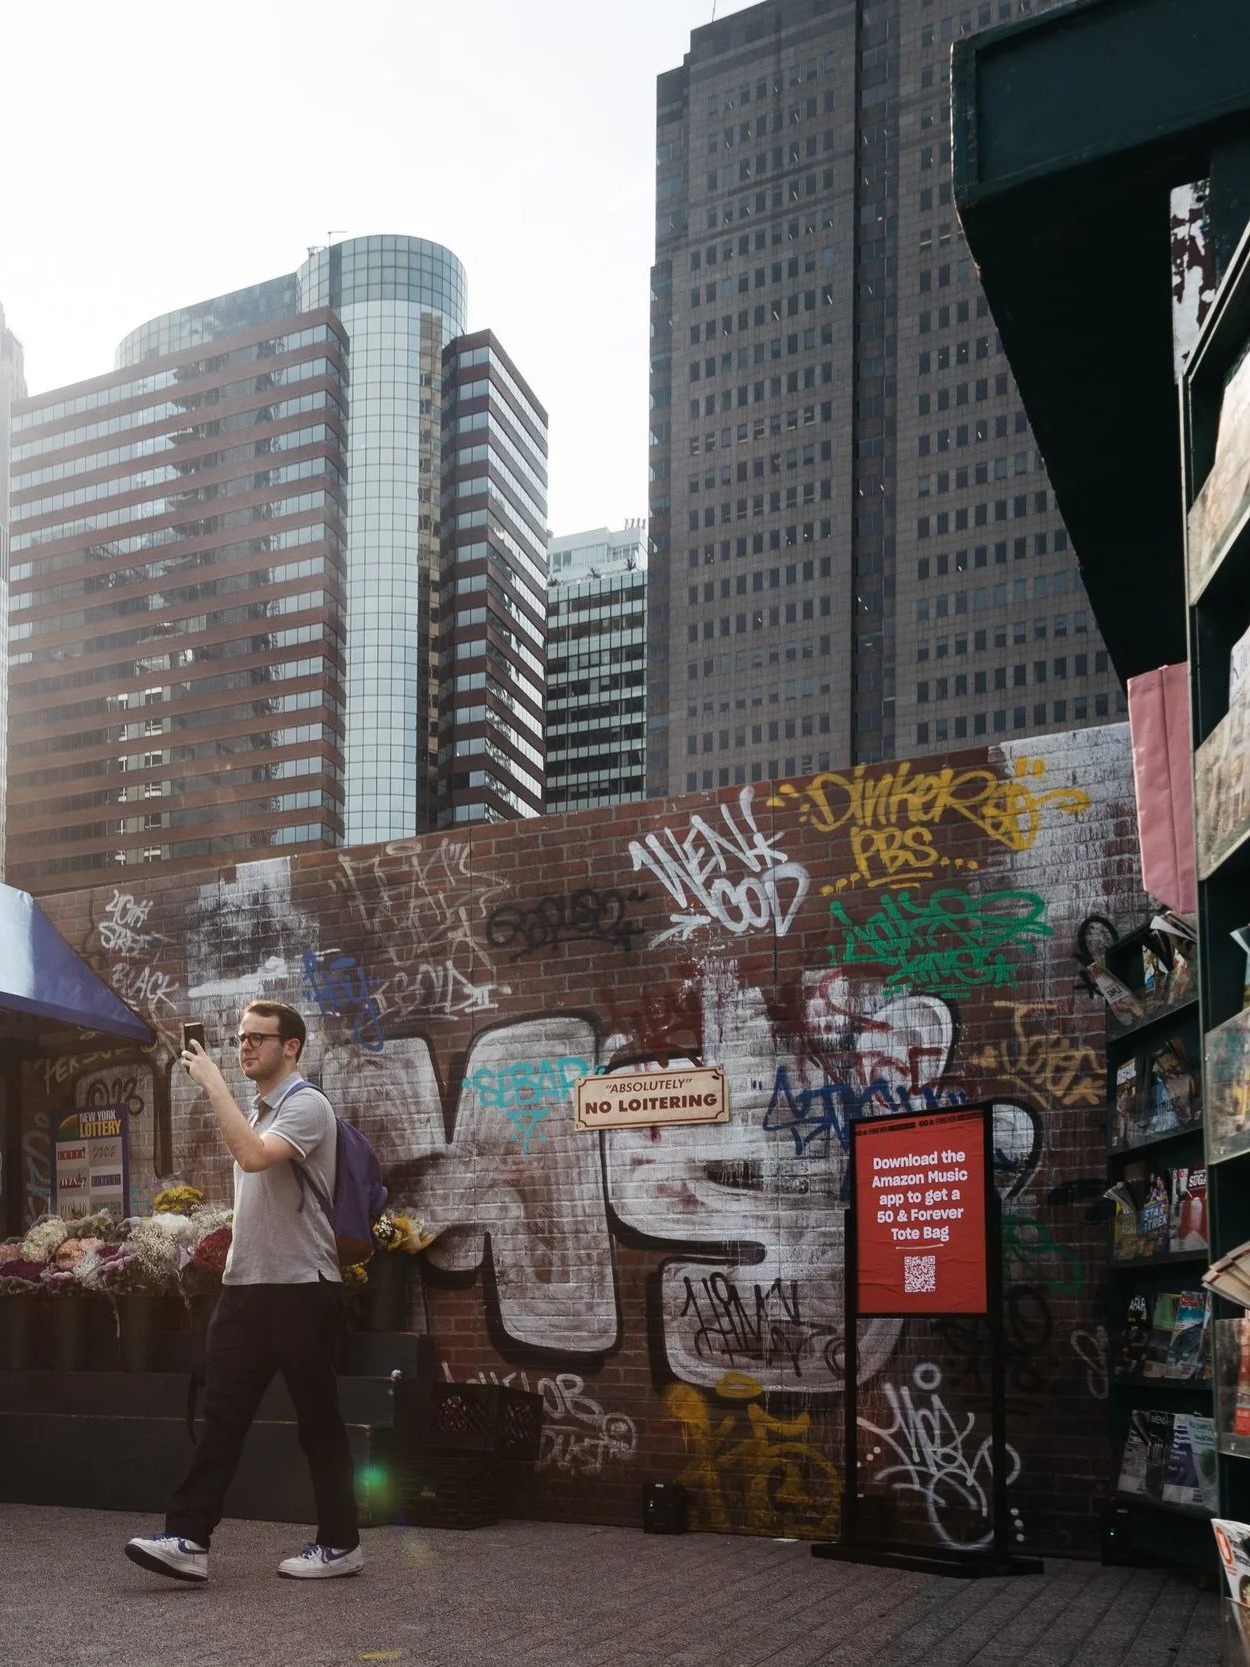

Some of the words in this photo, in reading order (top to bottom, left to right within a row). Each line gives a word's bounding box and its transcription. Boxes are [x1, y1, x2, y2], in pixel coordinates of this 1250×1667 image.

[585, 1101, 612, 1115] NO
[618, 1093, 717, 1113] LOITERING
[79, 1111, 96, 1123] NEW
[97, 1109, 116, 1121] YORK
[79, 1119, 122, 1138] LOTTERY
[873, 1151, 938, 1170] Download
[941, 1150, 966, 1163] the
[872, 1174, 925, 1188] Amazon
[928, 1167, 968, 1183] Music
[1188, 1174, 1207, 1187] SUGA
[879, 1193, 905, 1207] app
[906, 1190, 922, 1203] to
[924, 1189, 948, 1206] get
[951, 1189, 961, 1201] a
[877, 1210, 894, 1224] 50
[897, 1209, 908, 1222] &
[910, 1206, 964, 1221] Forever
[1144, 1205, 1166, 1221] STAR
[1147, 1214, 1168, 1230] TREK
[891, 1228, 920, 1241] Tote
[923, 1225, 950, 1242] Bag
